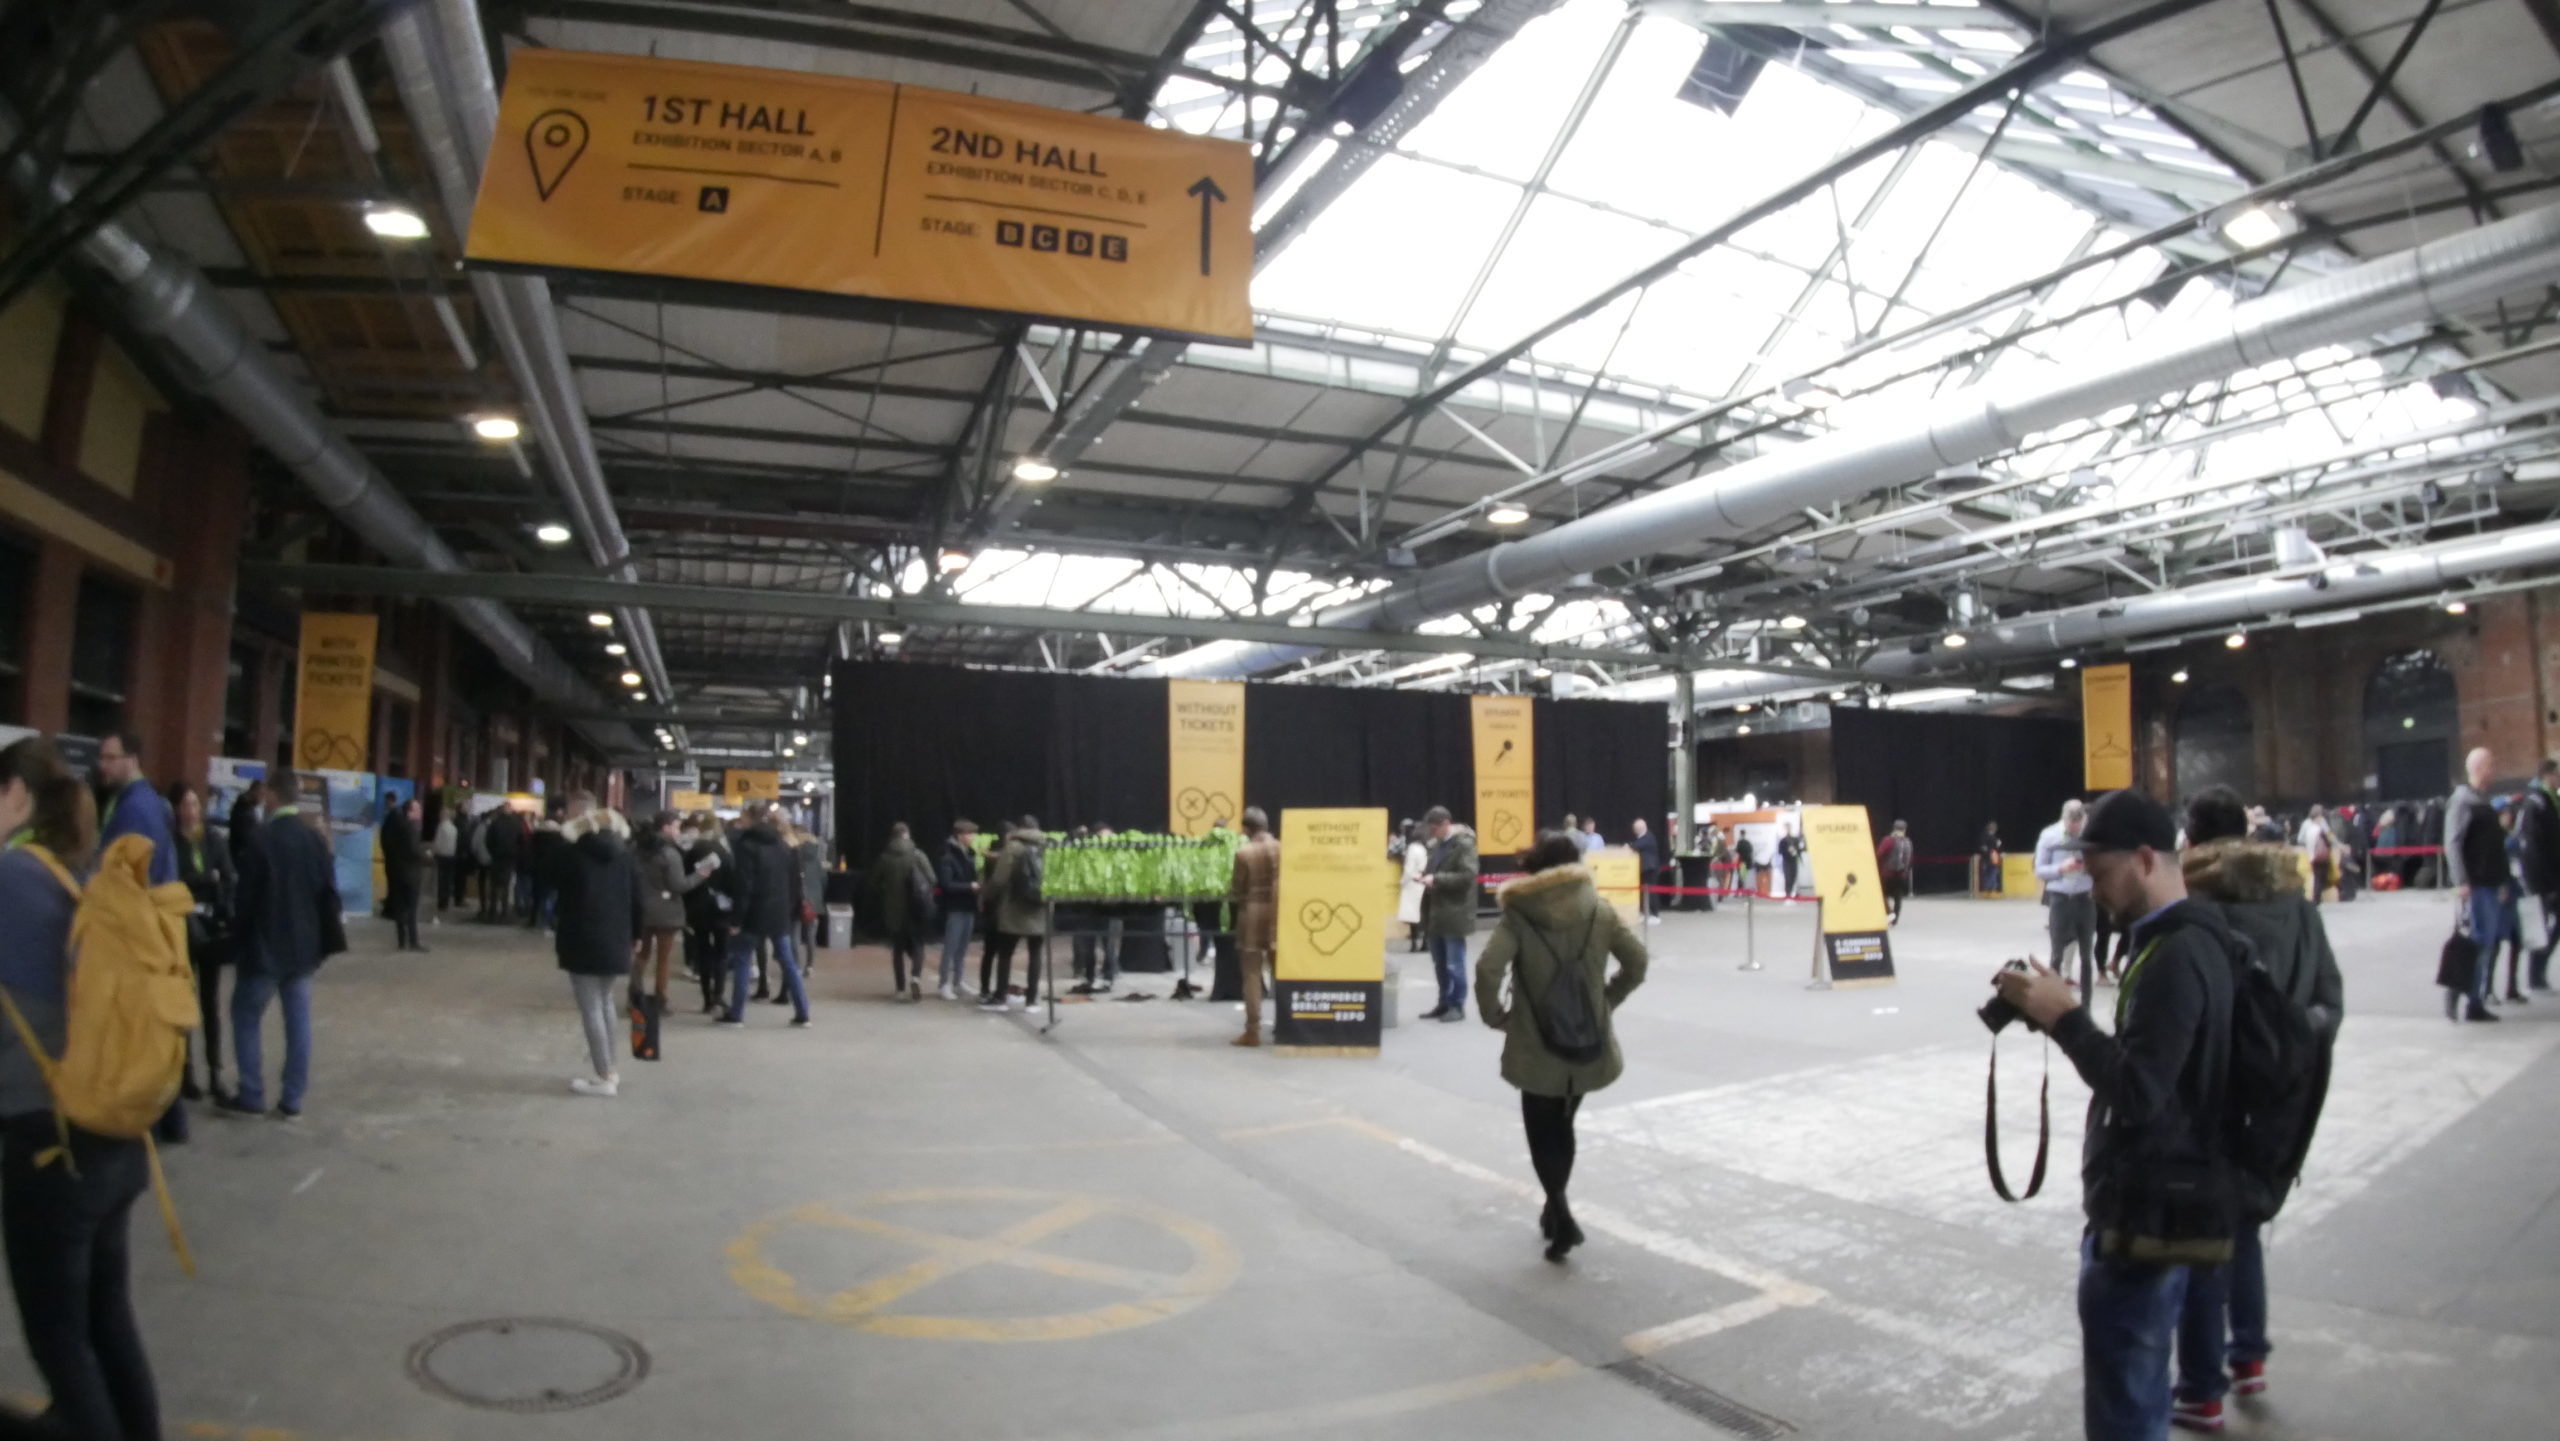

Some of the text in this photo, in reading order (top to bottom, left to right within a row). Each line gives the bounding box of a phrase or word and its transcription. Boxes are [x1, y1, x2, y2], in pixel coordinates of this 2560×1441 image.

[644, 94, 713, 126] 1ST
[719, 101, 815, 136] HALL
[632, 130, 732, 152] EXHIBITION
[736, 139, 805, 157] SECTOR
[929, 126, 1108, 178] 2ND HALL
[926, 160, 1025, 186] EXHIBITION
[1028, 174, 1094, 197] SECTOR
[307, 671, 363, 687] TICKETS
[1176, 702, 1237, 716] WITHOUT
[1180, 718, 1235, 732] TICKETS
[1307, 822, 1361, 832] WITHOUT
[1816, 823, 1859, 834] SPEAKER
[1309, 835, 1358, 846] TICKETS
